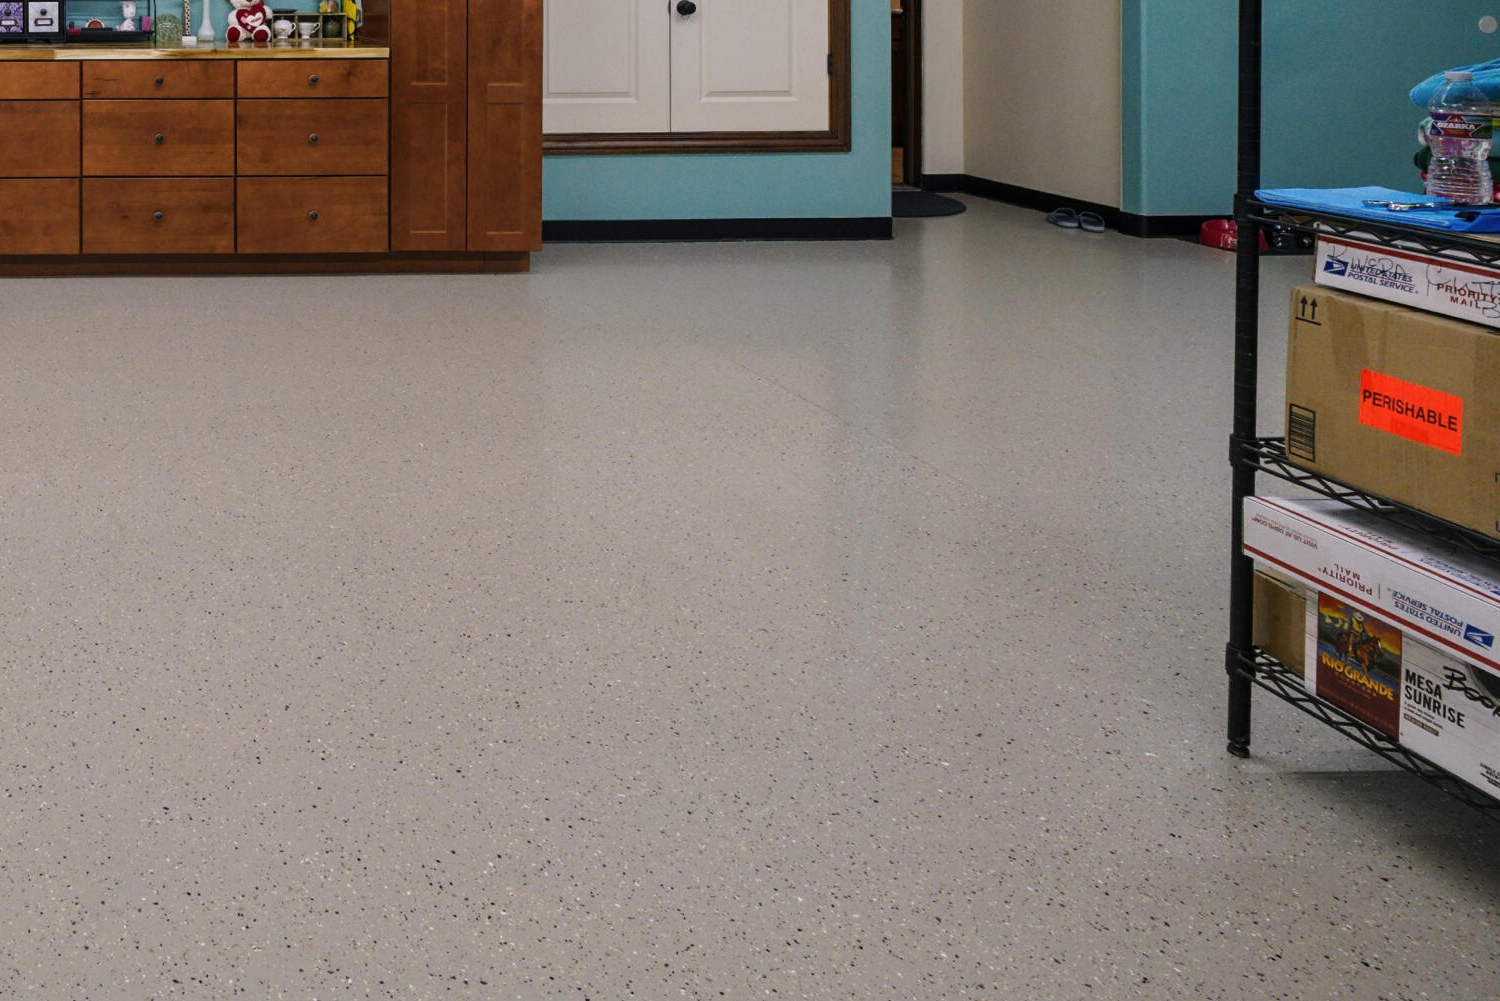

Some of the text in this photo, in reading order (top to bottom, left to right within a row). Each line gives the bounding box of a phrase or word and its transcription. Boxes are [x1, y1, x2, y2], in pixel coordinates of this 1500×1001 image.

[1437, 122, 1476, 130] OZARKA
[1348, 272, 1415, 294] POSTAL SERVICE
[1350, 262, 1413, 283] UNITED STATES
[1436, 282, 1499, 304] PRIORITY
[1450, 295, 1482, 310] MAIL
[1363, 389, 1458, 432] PERISHABLE
[1321, 566, 1373, 596] PRIORITY
[1333, 563, 1361, 581] MAIL
[1391, 591, 1463, 627] POSTAL SERVICE
[1394, 600, 1461, 637] UNITED STATES
[1322, 652, 1344, 673] RIO
[1344, 665, 1395, 701] GRANDE
[1405, 669, 1443, 700] MESA
[1404, 686, 1466, 729] SUNRISE
